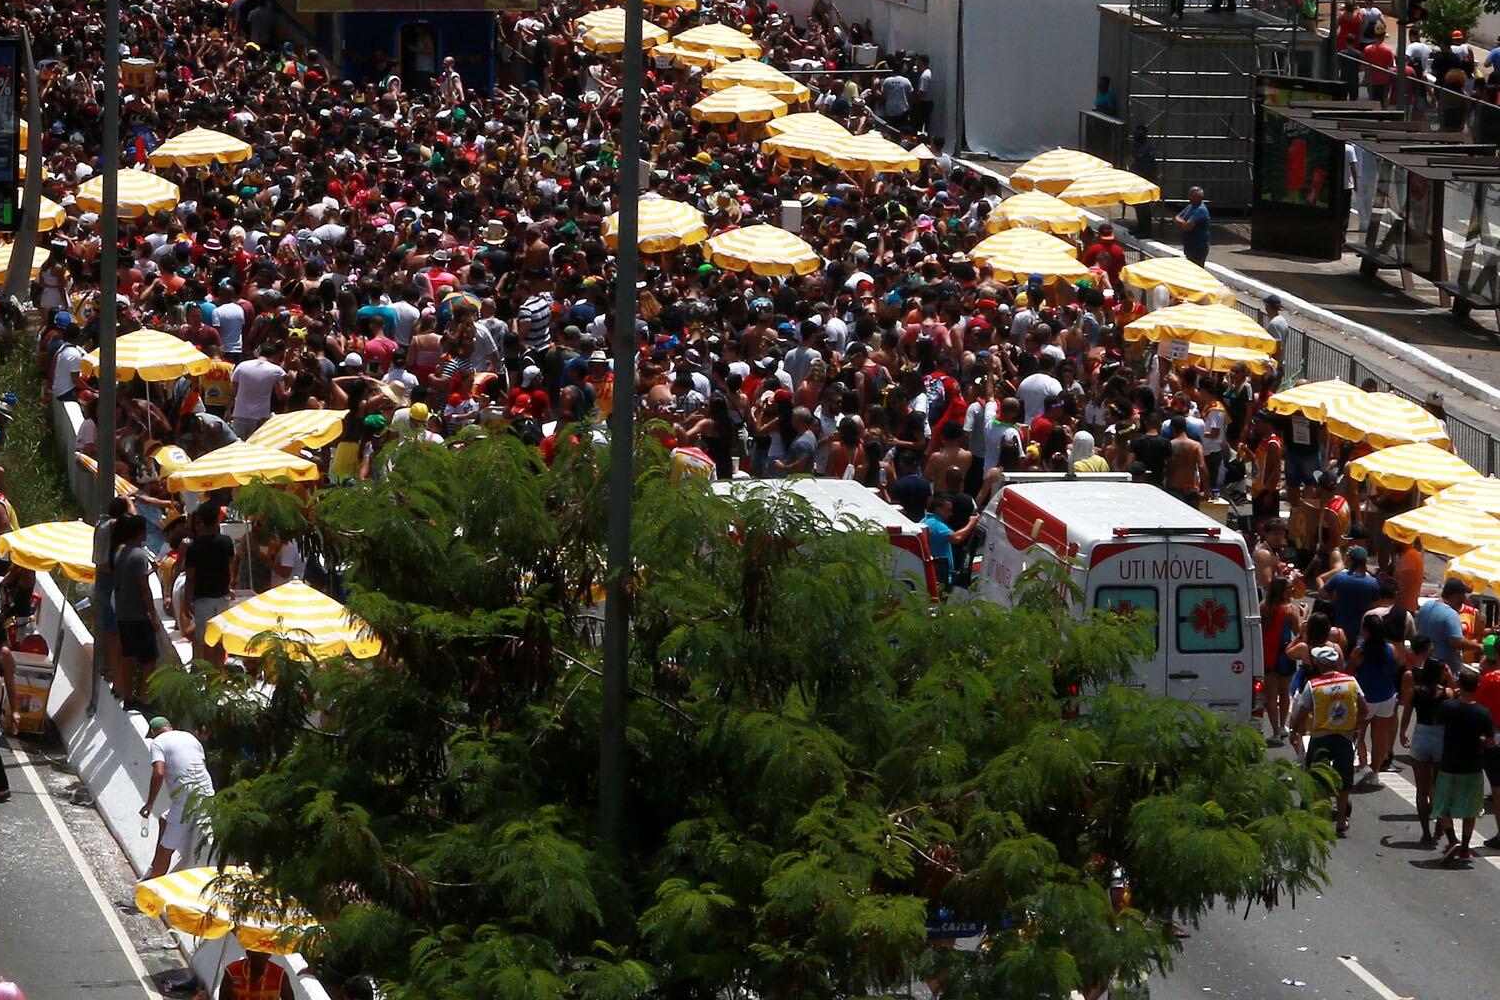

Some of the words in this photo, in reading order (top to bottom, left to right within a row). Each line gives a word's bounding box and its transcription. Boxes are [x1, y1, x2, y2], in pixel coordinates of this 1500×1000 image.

[1120, 560, 1146, 580] UTI
[1153, 555, 1213, 580] MÓVEL
[1233, 663, 1243, 671] 23
